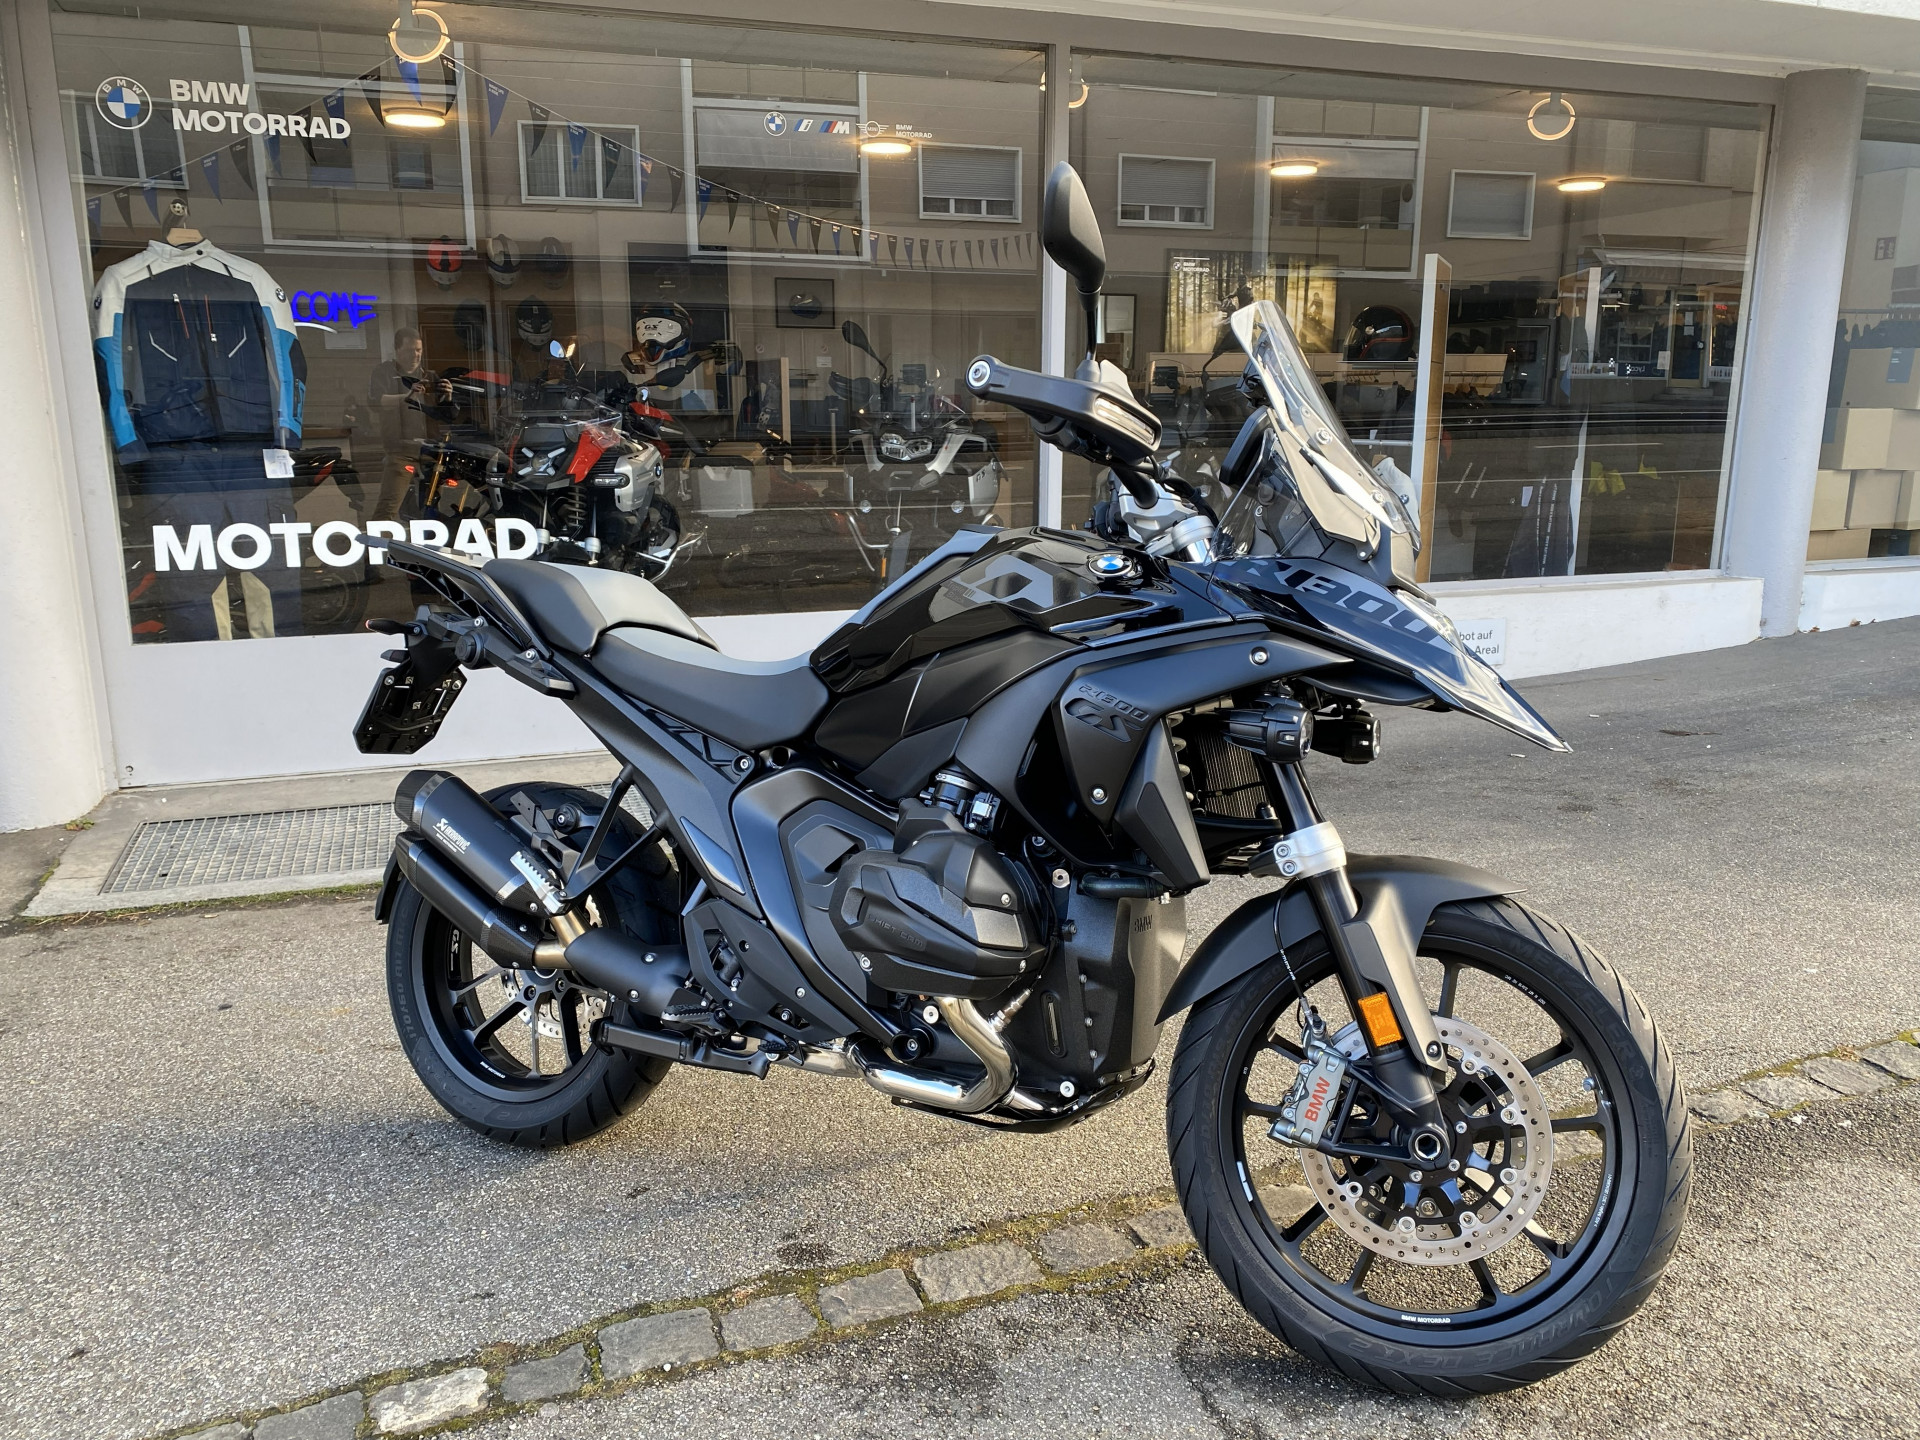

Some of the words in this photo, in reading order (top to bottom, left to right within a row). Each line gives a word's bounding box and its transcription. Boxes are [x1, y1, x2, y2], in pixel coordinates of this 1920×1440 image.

[102, 79, 142, 94] BMW
[169, 79, 249, 105] BMW
[172, 108, 351, 139] MOTORRAD
[895, 130, 933, 138] MOTORRAD
[291, 290, 377, 329] COME
[152, 517, 539, 572] MOTORRAD
[1477, 629, 1493, 640] auf
[1475, 644, 1499, 655] Areal
[1304, 1076, 1331, 1123] BMW
[1401, 1314, 1416, 1322] BMW
[1417, 1316, 1451, 1324] MOTORRAD
